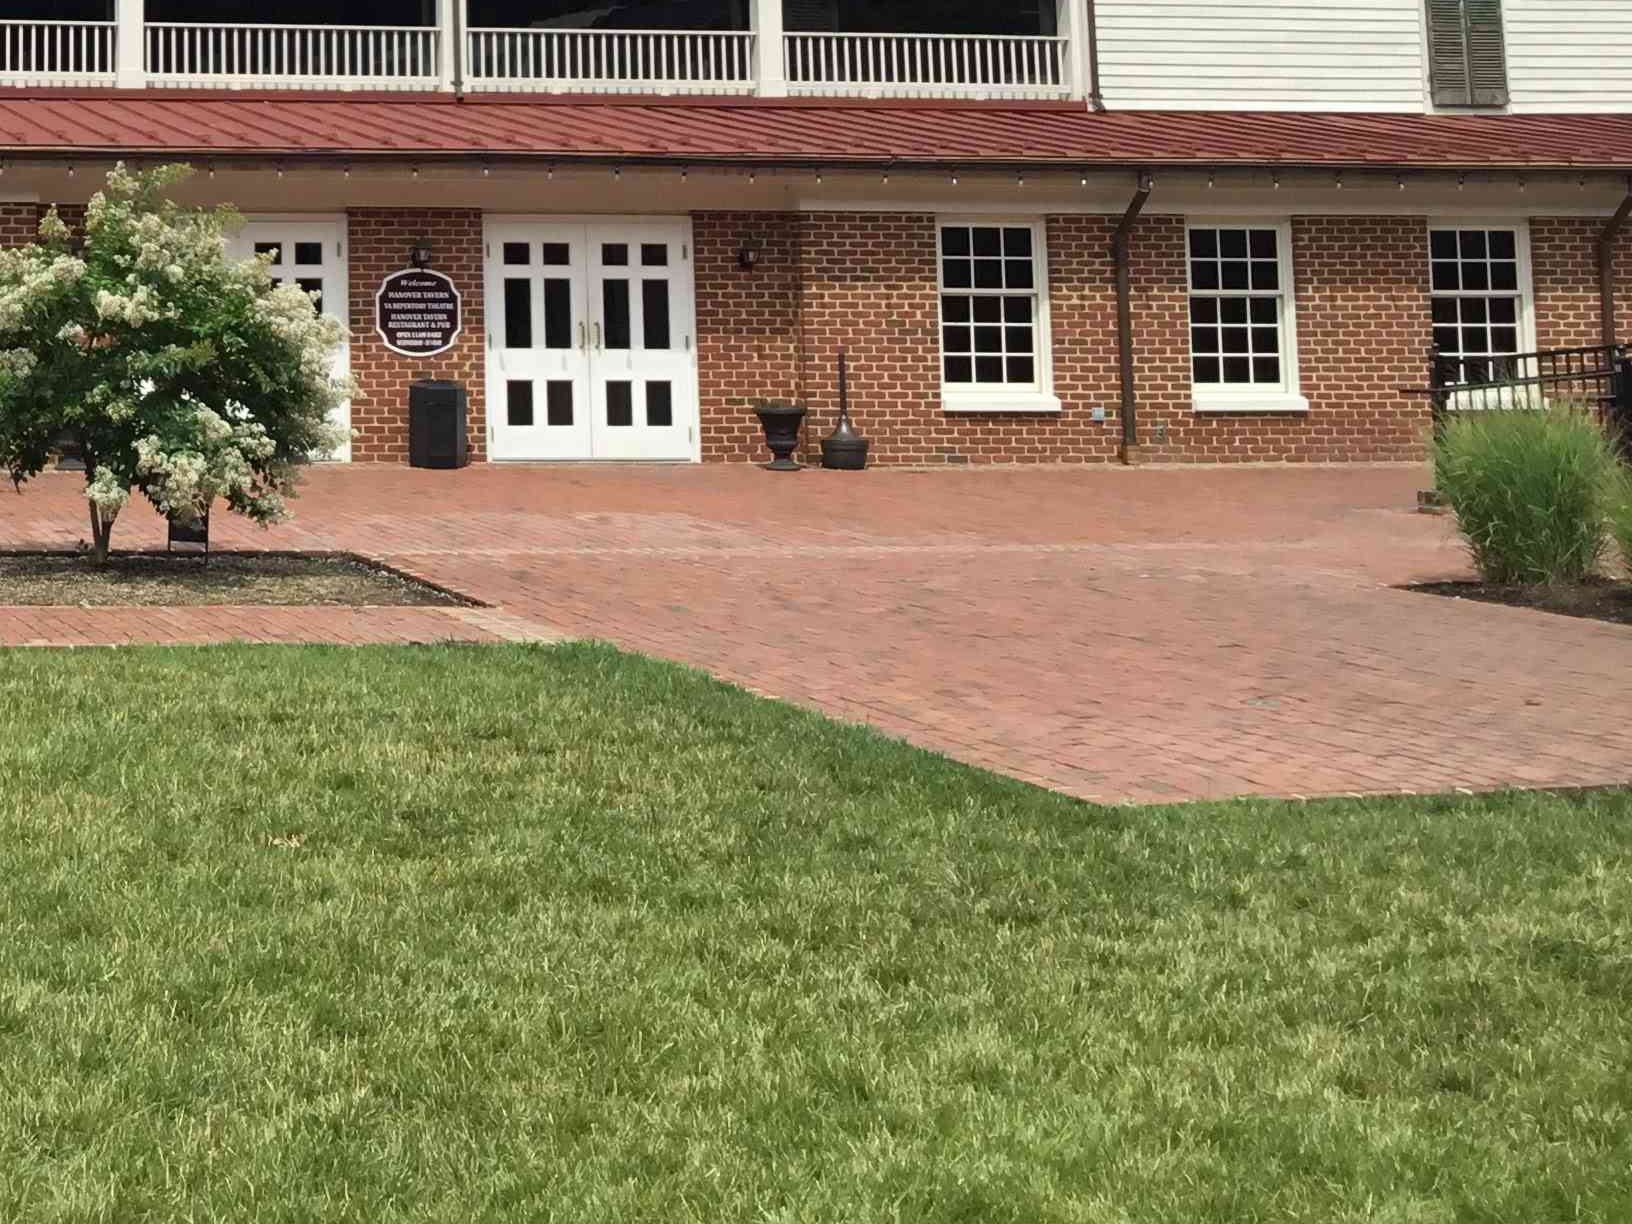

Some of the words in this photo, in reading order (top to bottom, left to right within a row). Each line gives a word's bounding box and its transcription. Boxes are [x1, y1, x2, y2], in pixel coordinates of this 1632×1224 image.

[400, 279, 437, 287] Welcome
[388, 291, 422, 299] HANOVER
[422, 291, 449, 299] TAVERN
